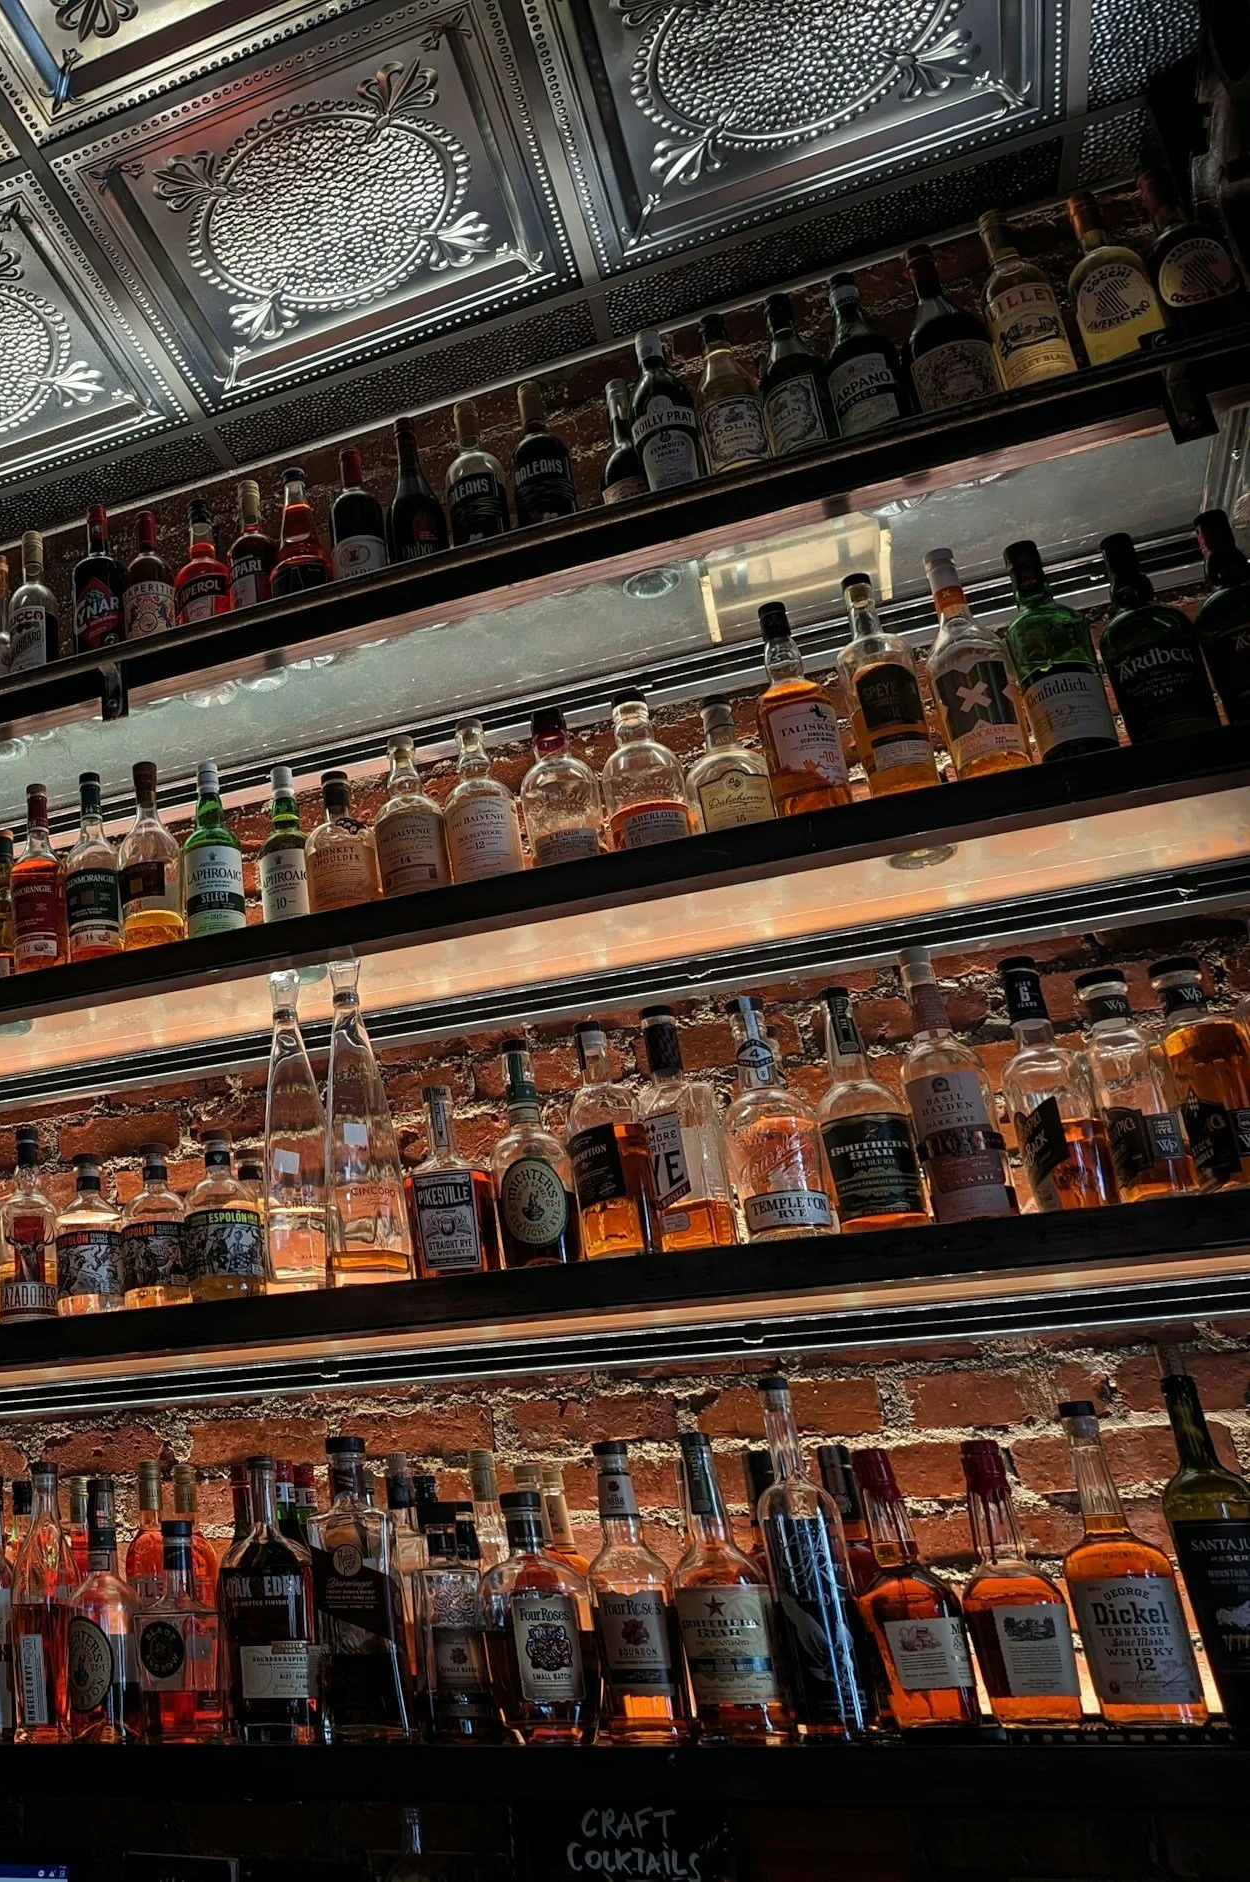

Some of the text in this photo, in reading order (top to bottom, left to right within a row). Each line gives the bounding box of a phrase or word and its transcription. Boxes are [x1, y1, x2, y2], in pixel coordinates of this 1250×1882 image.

[1087, 271, 1130, 293] COCCHI
[836, 371, 890, 403] ARPANO
[634, 413, 665, 438] NOILLY
[714, 421, 757, 438] DOLIN
[516, 459, 563, 486] ORLEANS
[824, 751, 834, 763] 10
[464, 813, 505, 825] BALVENIE
[631, 811, 679, 825] ABERLOUR
[390, 828, 431, 839] BALVENIE
[475, 841, 486, 850] 12
[314, 846, 354, 859] MONKEY
[313, 855, 360, 869] SHOULDER
[201, 892, 230, 903] SELECT
[276, 898, 287, 910] 10
[1019, 988, 1031, 1002] 6
[749, 1048, 760, 1058] 4
[926, 1093, 964, 1106] BASIL
[921, 1101, 972, 1116] HAYDEN
[831, 1140, 909, 1157] SOUTHERN
[850, 1149, 895, 1161] STAR
[350, 1186, 396, 1198] CINCORO
[417, 1185, 469, 1205] PIKESVILLE
[284, 1199, 329, 1211] CINCOR
[751, 1196, 827, 1212] TEMPLETON
[777, 1207, 806, 1220] RYE
[428, 1238, 473, 1250] STRAIGHT RYE
[1191, 1538, 1233, 1552] SANTA
[264, 1575, 302, 1597] EDEN
[1103, 1587, 1150, 1601] GEORGE
[519, 1608, 569, 1621] Four Roses
[603, 1599, 662, 1617] Four Roses
[1091, 1602, 1170, 1626] Dickel
[683, 1618, 760, 1631] SOUTHERN
[697, 1629, 742, 1638] STAR
[1100, 1627, 1170, 1639] TENNESSEE
[1111, 1637, 1165, 1648] Sour Mash
[618, 1648, 657, 1657] BOURBON
[1105, 1647, 1174, 1658] WHISKY
[1137, 1657, 1157, 1671] 12
[532, 1673, 573, 1681] SMALL BATCH
[581, 1806, 677, 1840] CRAFT
